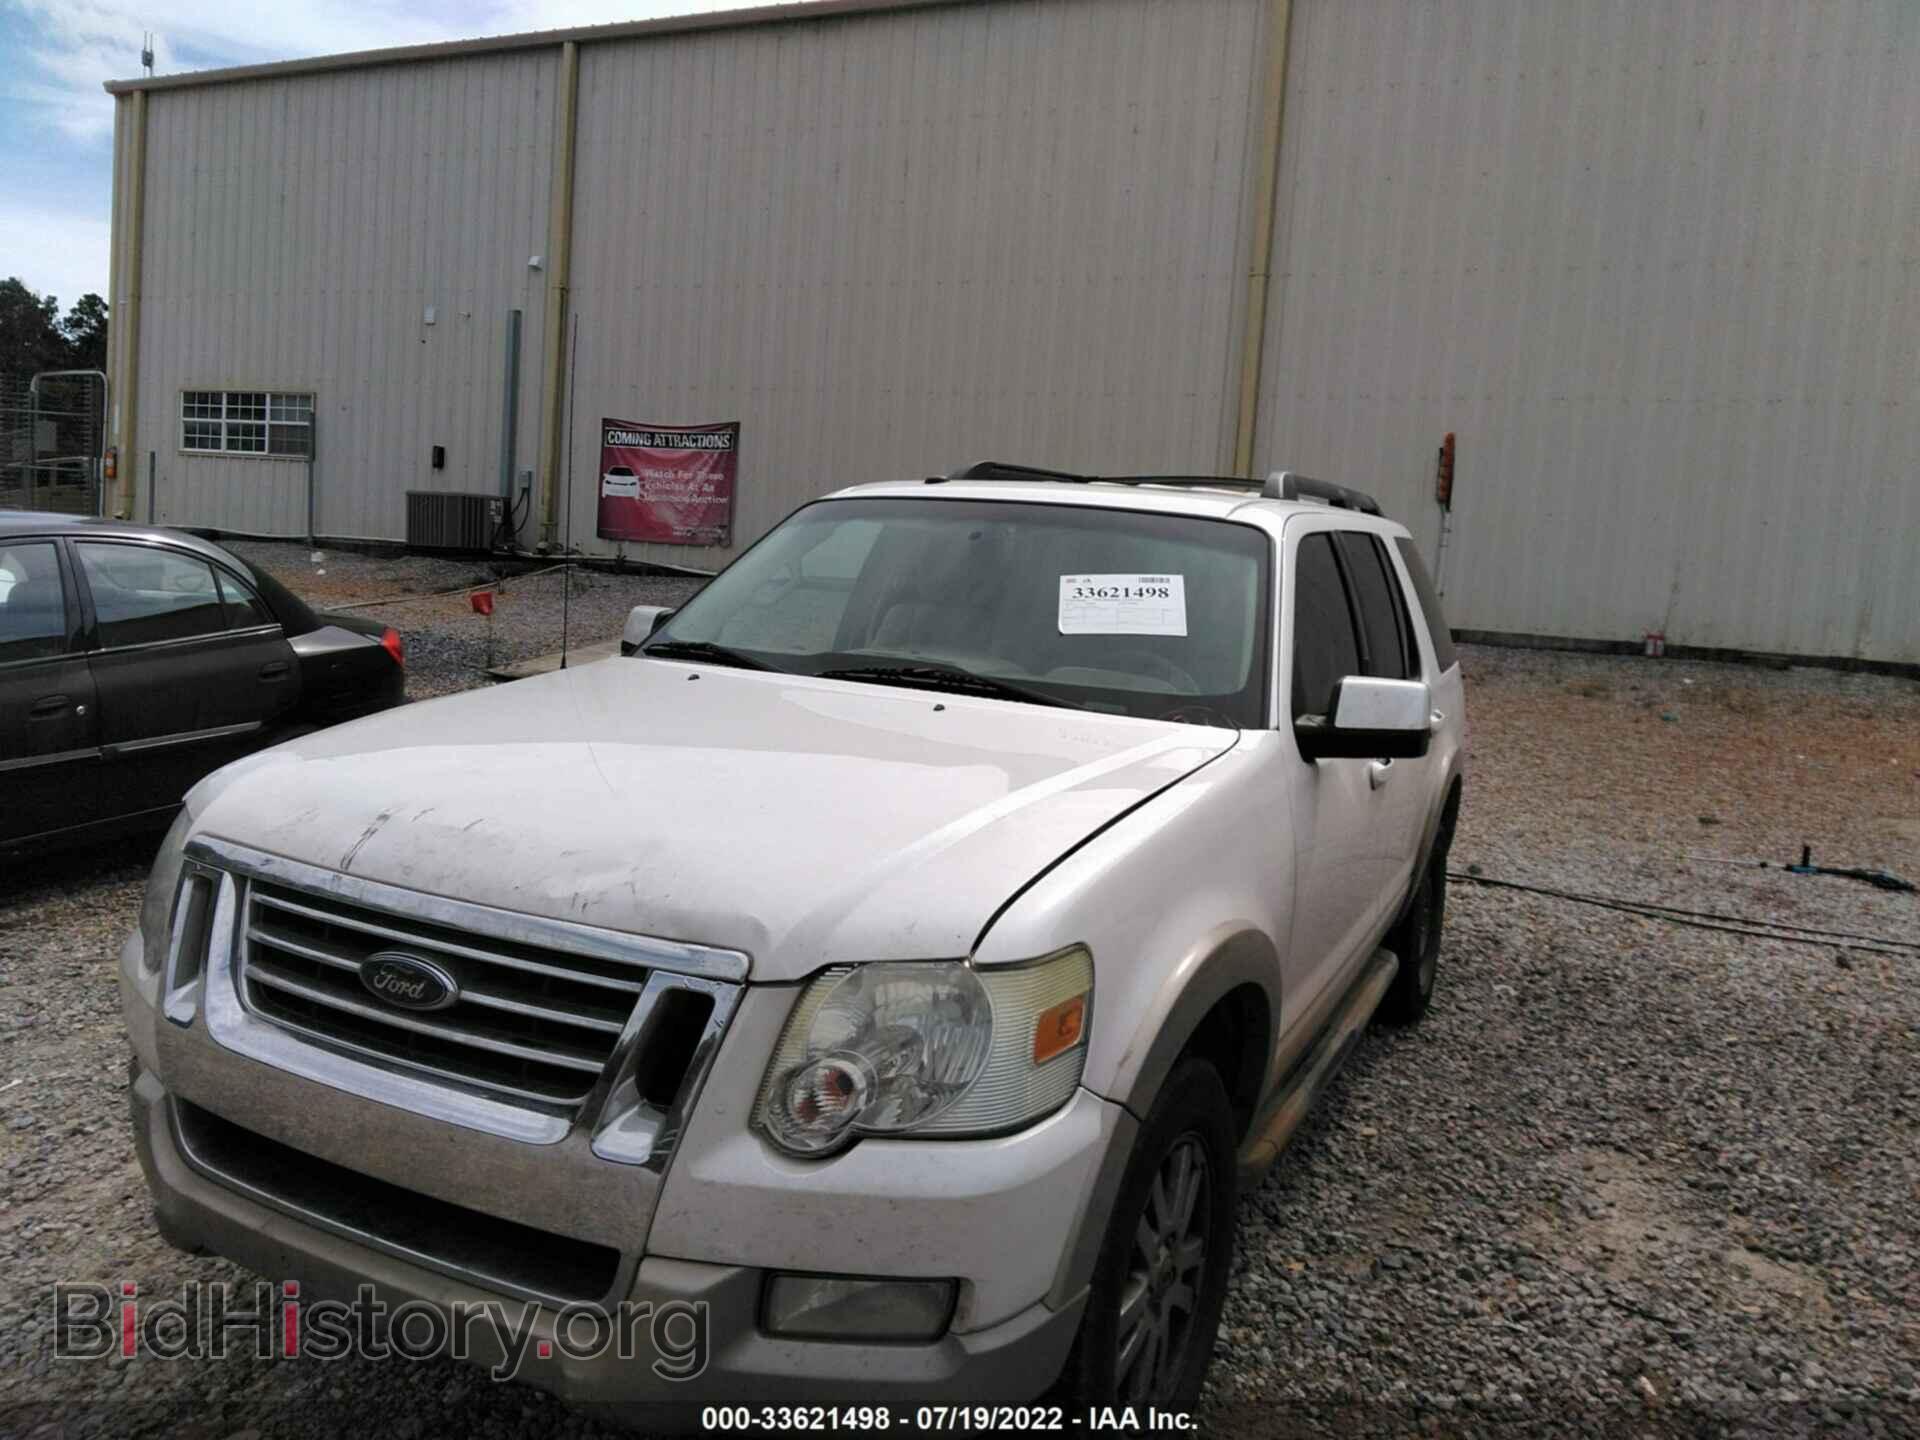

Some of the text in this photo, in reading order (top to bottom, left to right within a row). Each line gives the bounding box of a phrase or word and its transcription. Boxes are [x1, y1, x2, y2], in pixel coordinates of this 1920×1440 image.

[607, 430, 730, 449] COMING ATTRACTIONS
[1072, 587, 1169, 599] 33621498
[374, 964, 426, 999] Ford
